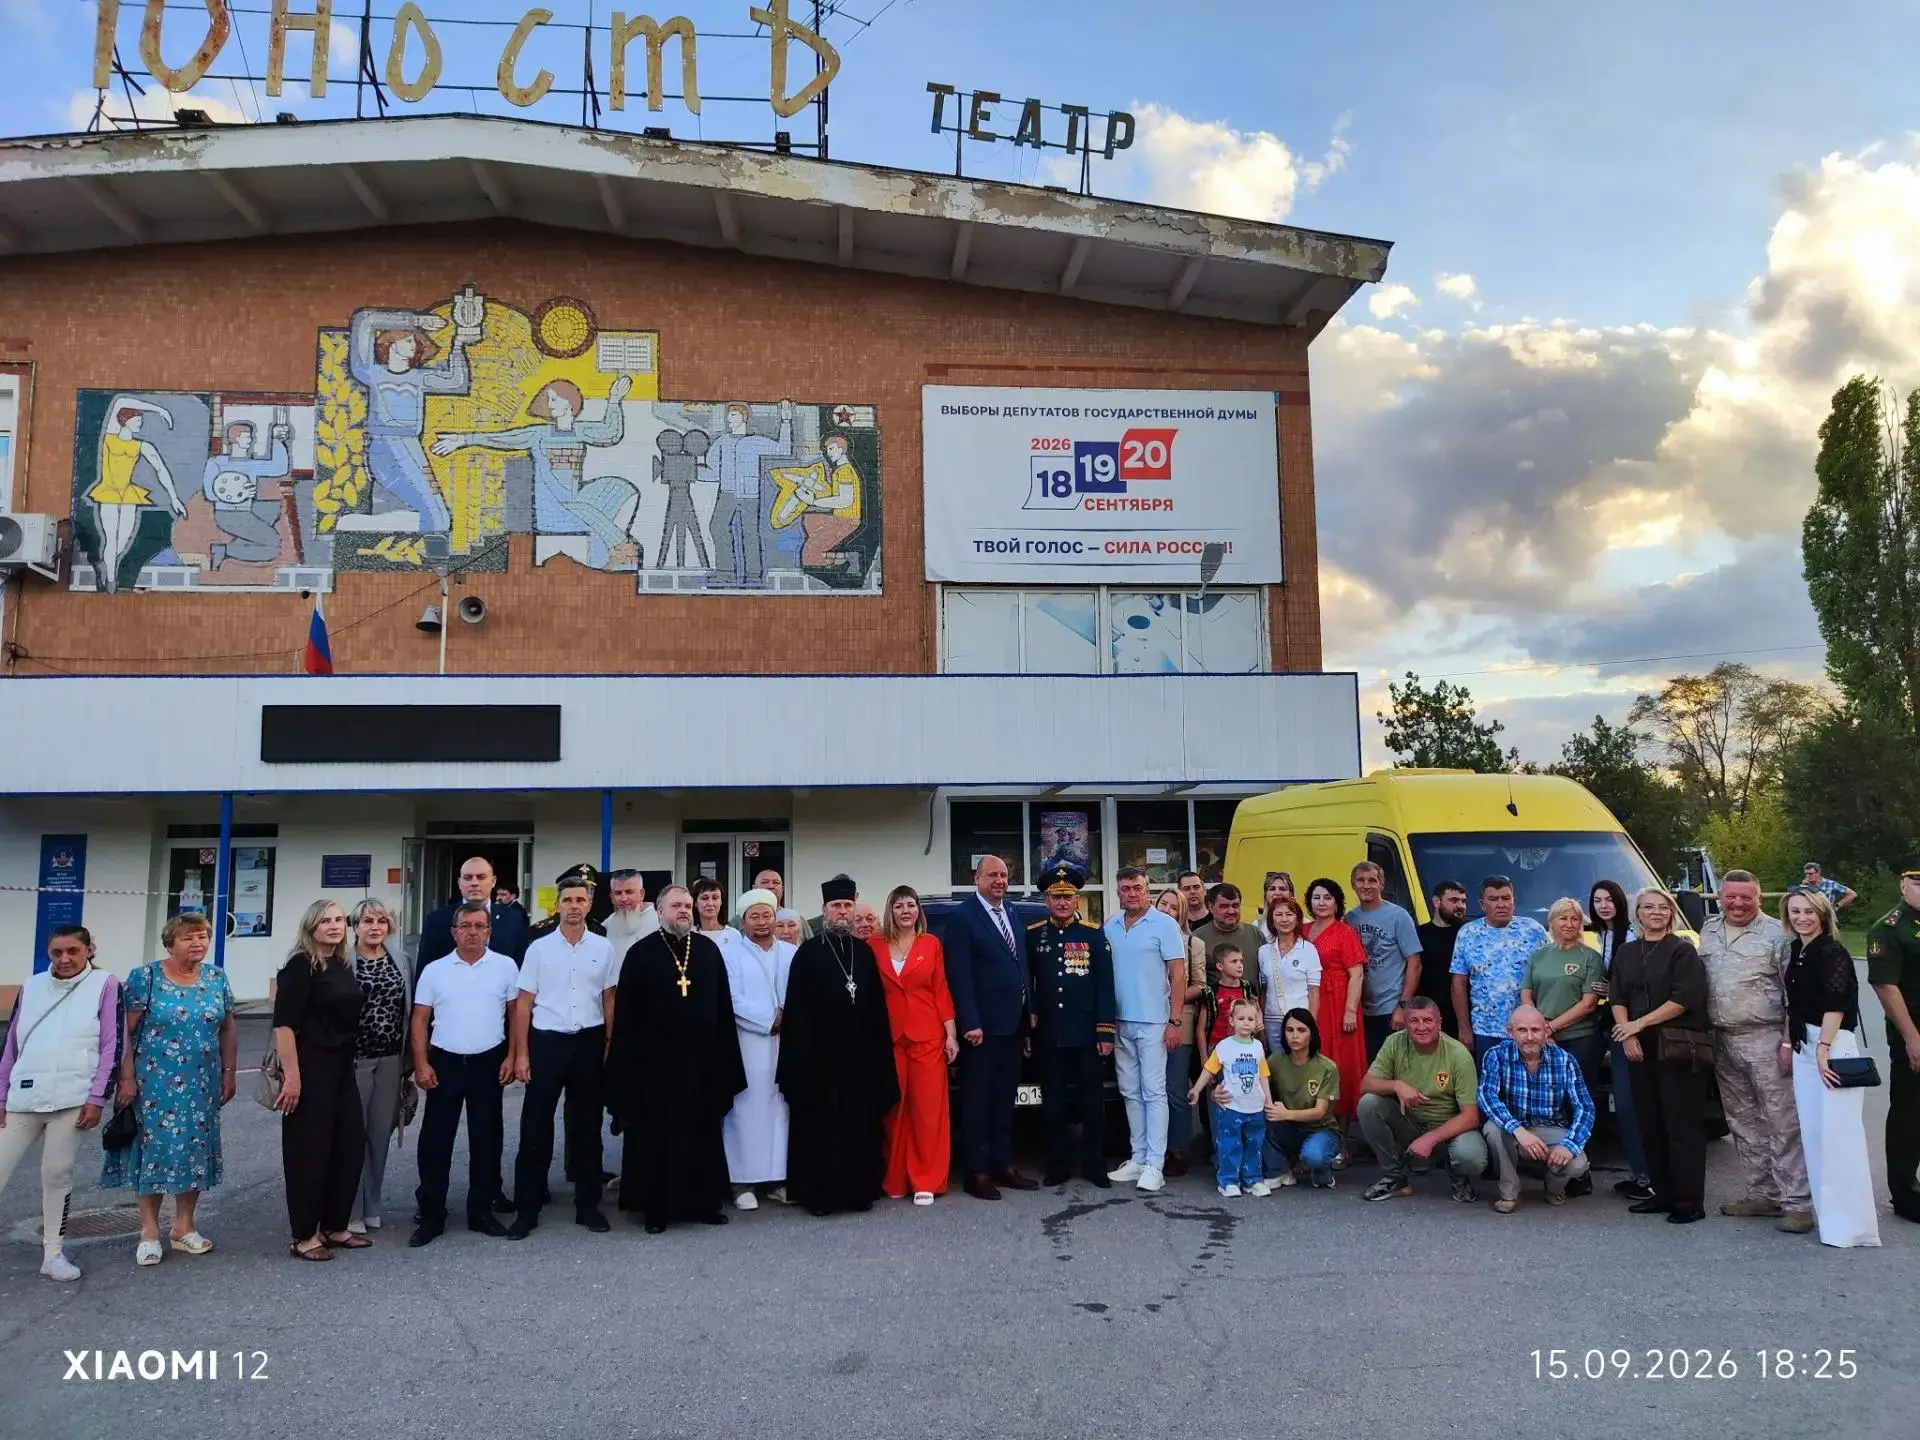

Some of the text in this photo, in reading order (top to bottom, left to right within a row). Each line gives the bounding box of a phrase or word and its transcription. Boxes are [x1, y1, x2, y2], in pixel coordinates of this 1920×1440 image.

[926, 82, 1136, 160] ТЕАТР
[941, 405, 1257, 420] ВЫБОРЫ ДЕПУТАТОВ ГОСУДАРСТВЕННОЙ ДУМЫ
[1031, 438, 1071, 450] 2026
[1036, 440, 1167, 498] 18 19 20
[1084, 498, 1174, 511] СЕНТЯБРЯ
[973, 538, 1020, 554] ТВОЙ
[1026, 541, 1084, 554] ГОЛОС
[1104, 541, 1152, 554] СИЛА
[1157, 541, 1233, 554] РОСС!
